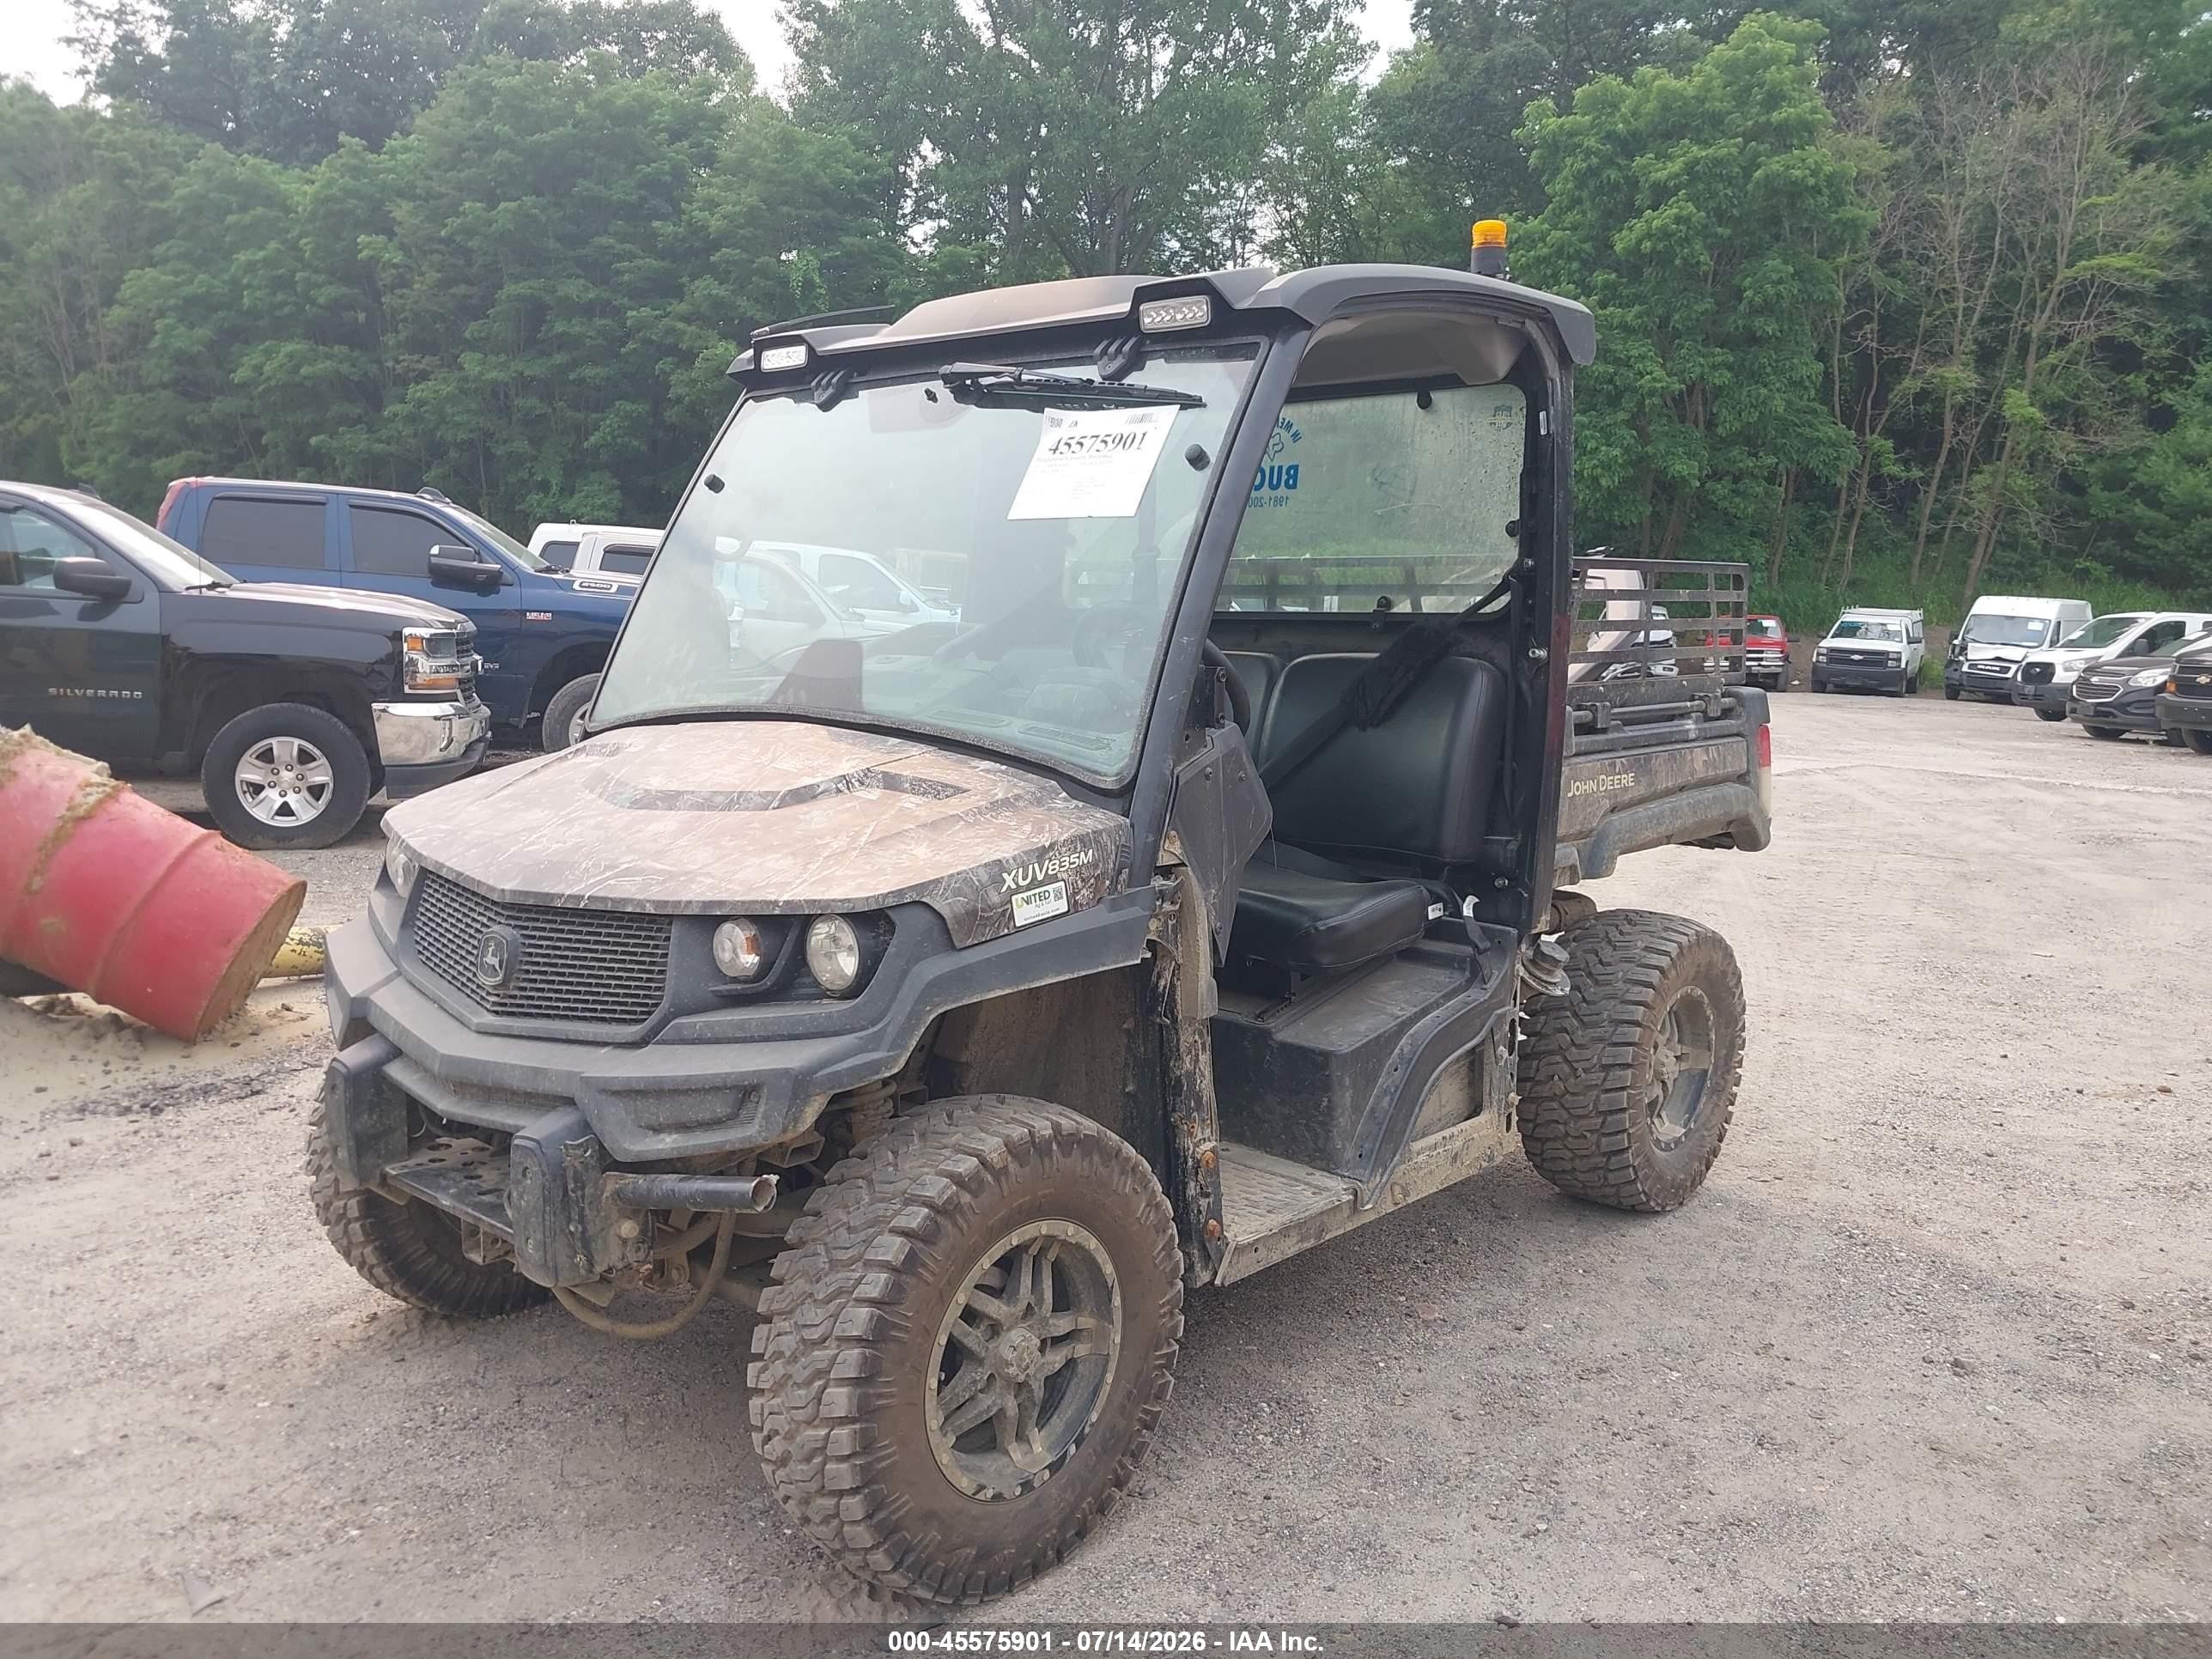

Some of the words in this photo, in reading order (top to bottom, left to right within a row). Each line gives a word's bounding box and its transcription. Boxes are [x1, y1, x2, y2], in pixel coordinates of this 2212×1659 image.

[1048, 431, 1148, 455] 45575901
[47, 688, 143, 699] SILVERADO
[1567, 779, 1598, 798] JOHN
[1599, 773, 1635, 792] DEERE
[1000, 848, 1093, 893] XUV835M
